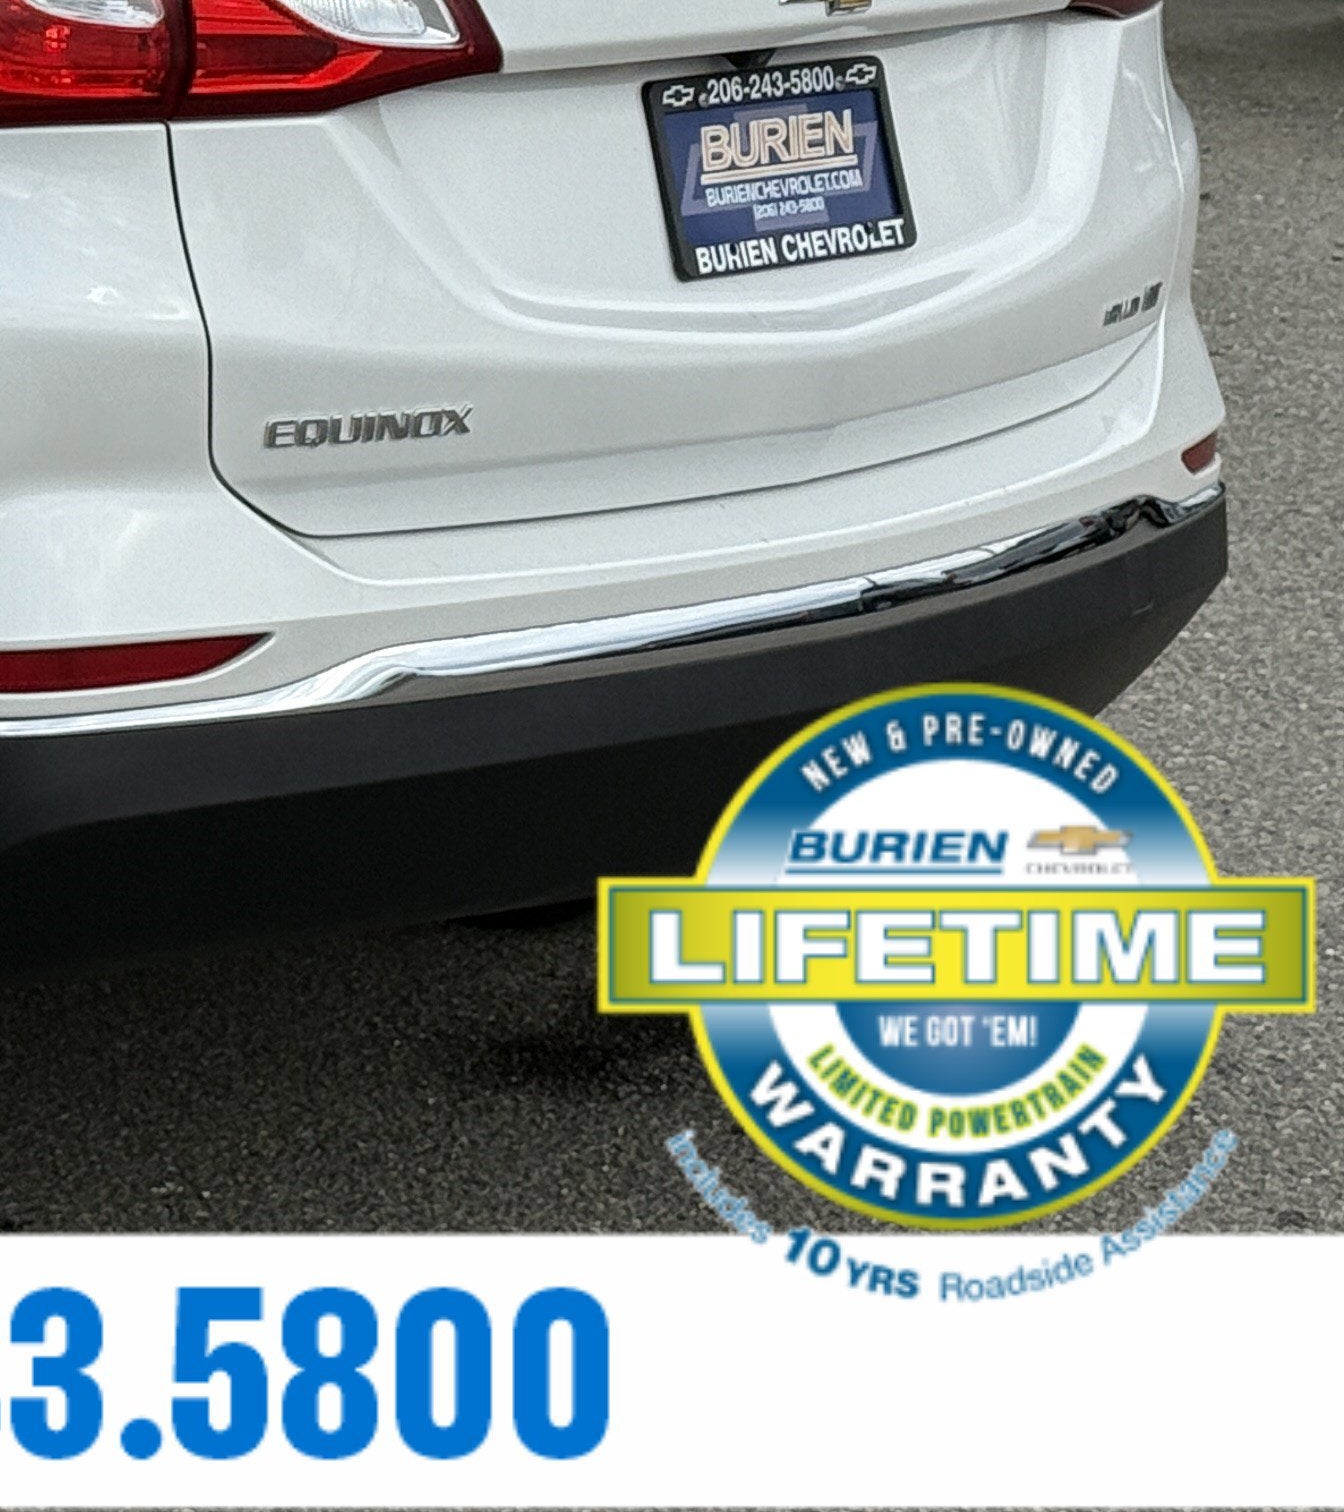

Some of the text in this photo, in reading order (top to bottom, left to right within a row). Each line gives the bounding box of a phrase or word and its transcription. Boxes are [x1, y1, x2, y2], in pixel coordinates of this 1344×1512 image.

[707, 65, 834, 105] 206-243-5800
[700, 108, 855, 172] BURIEN
[705, 168, 863, 208] BURIENCHEVROLET.COM
[695, 218, 906, 275] BURIEN CHEVROLET
[264, 402, 473, 449] EQUINOX
